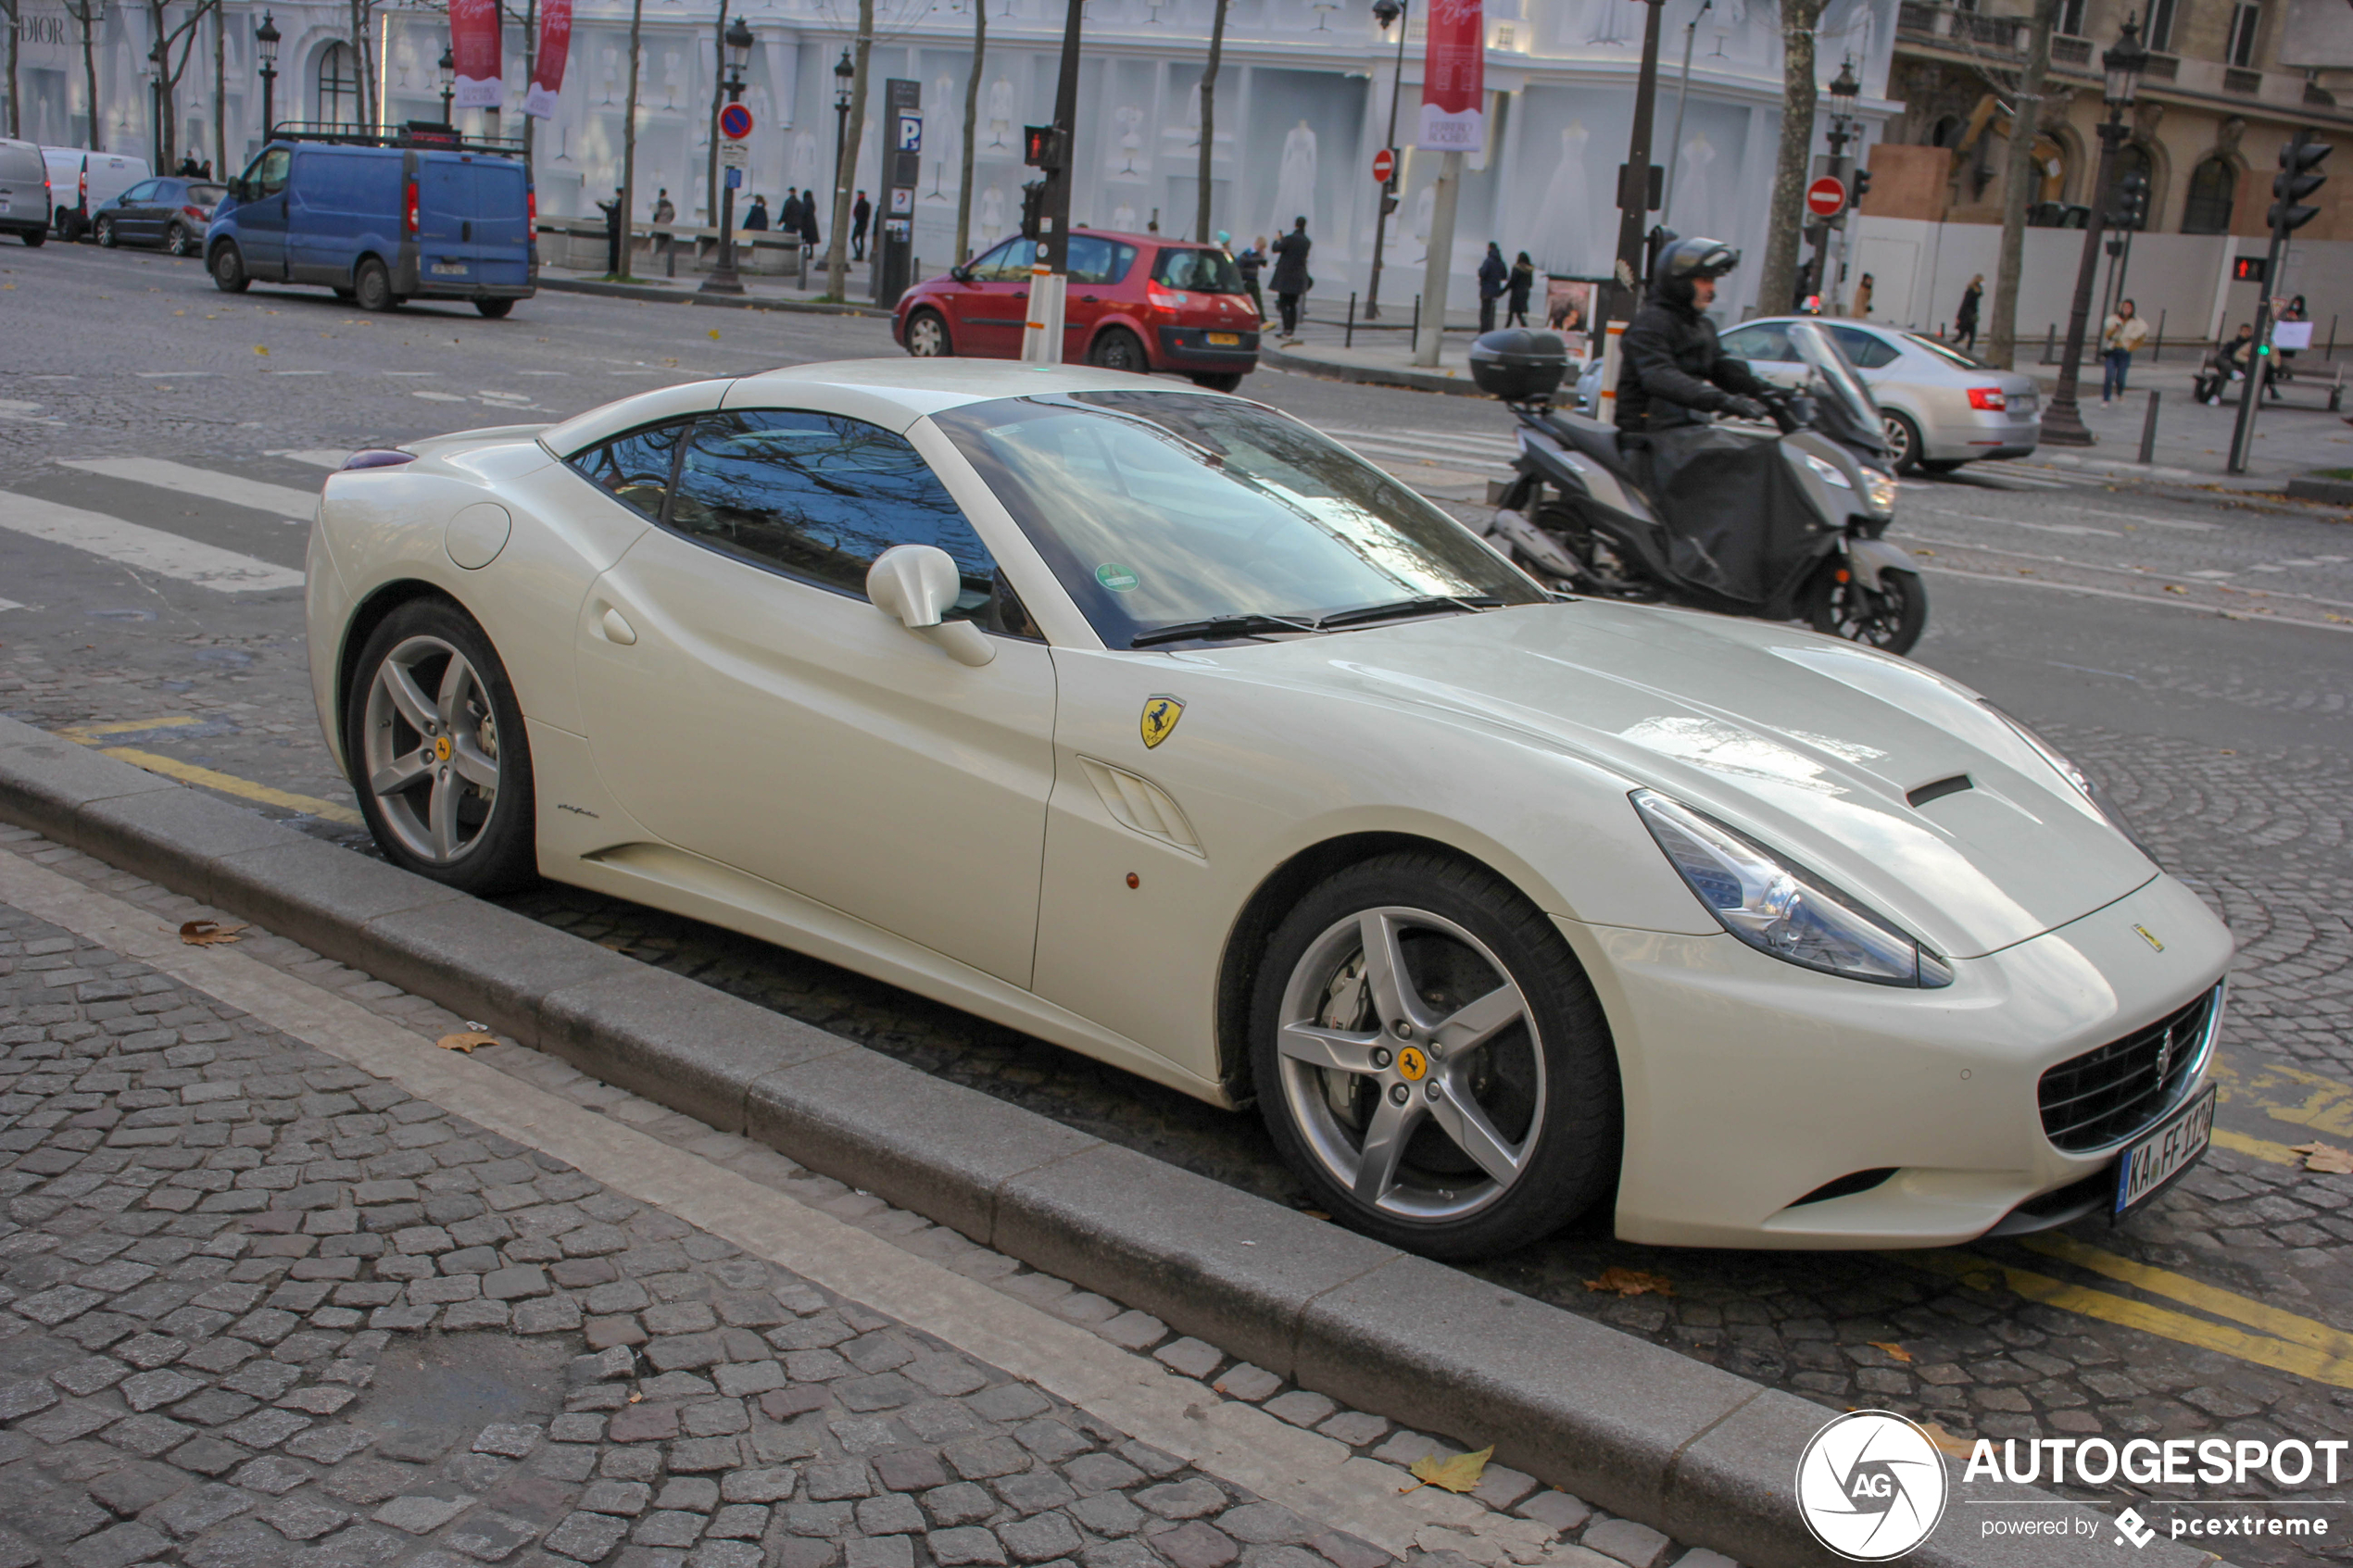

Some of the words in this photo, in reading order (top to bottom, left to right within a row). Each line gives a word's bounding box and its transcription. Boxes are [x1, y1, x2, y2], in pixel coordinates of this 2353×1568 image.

[20, 15, 65, 45] DIOR
[900, 119, 920, 149] P
[2128, 1144, 2151, 1198] KA
[2160, 1122, 2183, 1175] FF
